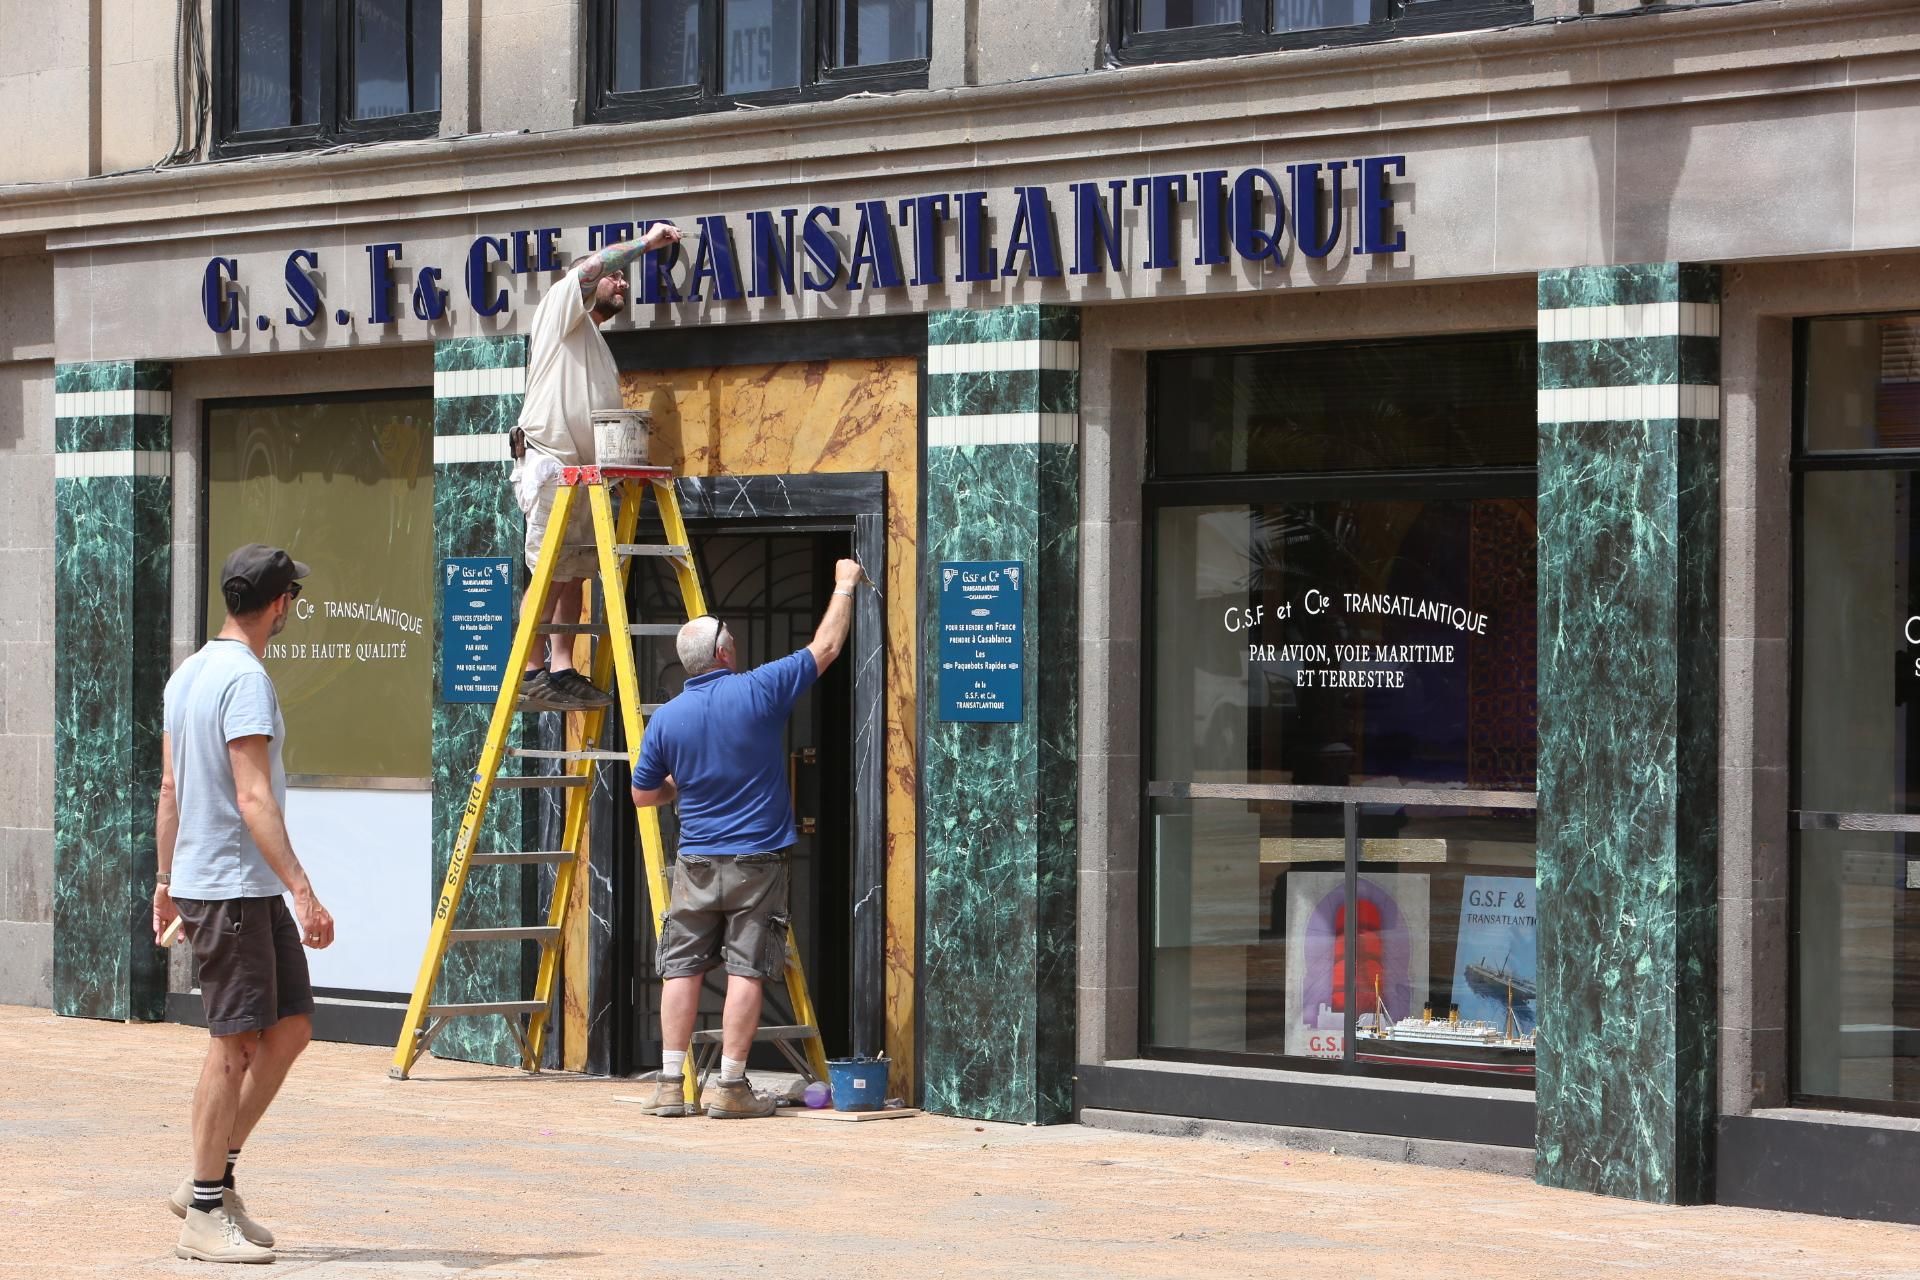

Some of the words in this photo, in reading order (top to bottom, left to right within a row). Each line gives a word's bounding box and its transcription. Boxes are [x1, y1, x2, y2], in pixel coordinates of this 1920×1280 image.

[413, 266, 449, 321] &
[589, 156, 1406, 304] TRANSATLANTIQUE
[324, 601, 423, 635] TRANSATLANTIQUE
[1277, 601, 1291, 620] et
[1343, 593, 1488, 635] TRANSATLANTIQUE
[995, 622, 1016, 631] France
[972, 634, 976, 644] à
[977, 634, 1012, 644] Casablanca
[291, 644, 307, 659] DE
[311, 644, 351, 659] HAUTE
[355, 640, 407, 661] QUALITÉ
[975, 650, 986, 658] Les
[1249, 644, 1276, 662] PAR
[1280, 645, 1331, 665] AVION,
[1335, 644, 1370, 662] VOIE
[1375, 645, 1455, 664] MARITIME
[954, 661, 984, 672] Paquebots
[984, 661, 1007, 672] Rapides
[974, 681, 980, 689] de
[1296, 669, 1315, 687] ET
[1319, 670, 1405, 688] TERRESTRE
[454, 684, 463, 692] PAR
[464, 684, 475, 692] VOIE
[475, 684, 499, 692] TERRESTRE
[956, 701, 1005, 709] TRANSATLANTIQUE
[1513, 891, 1526, 908] &
[1466, 912, 1537, 926] TRANSATLANTI
